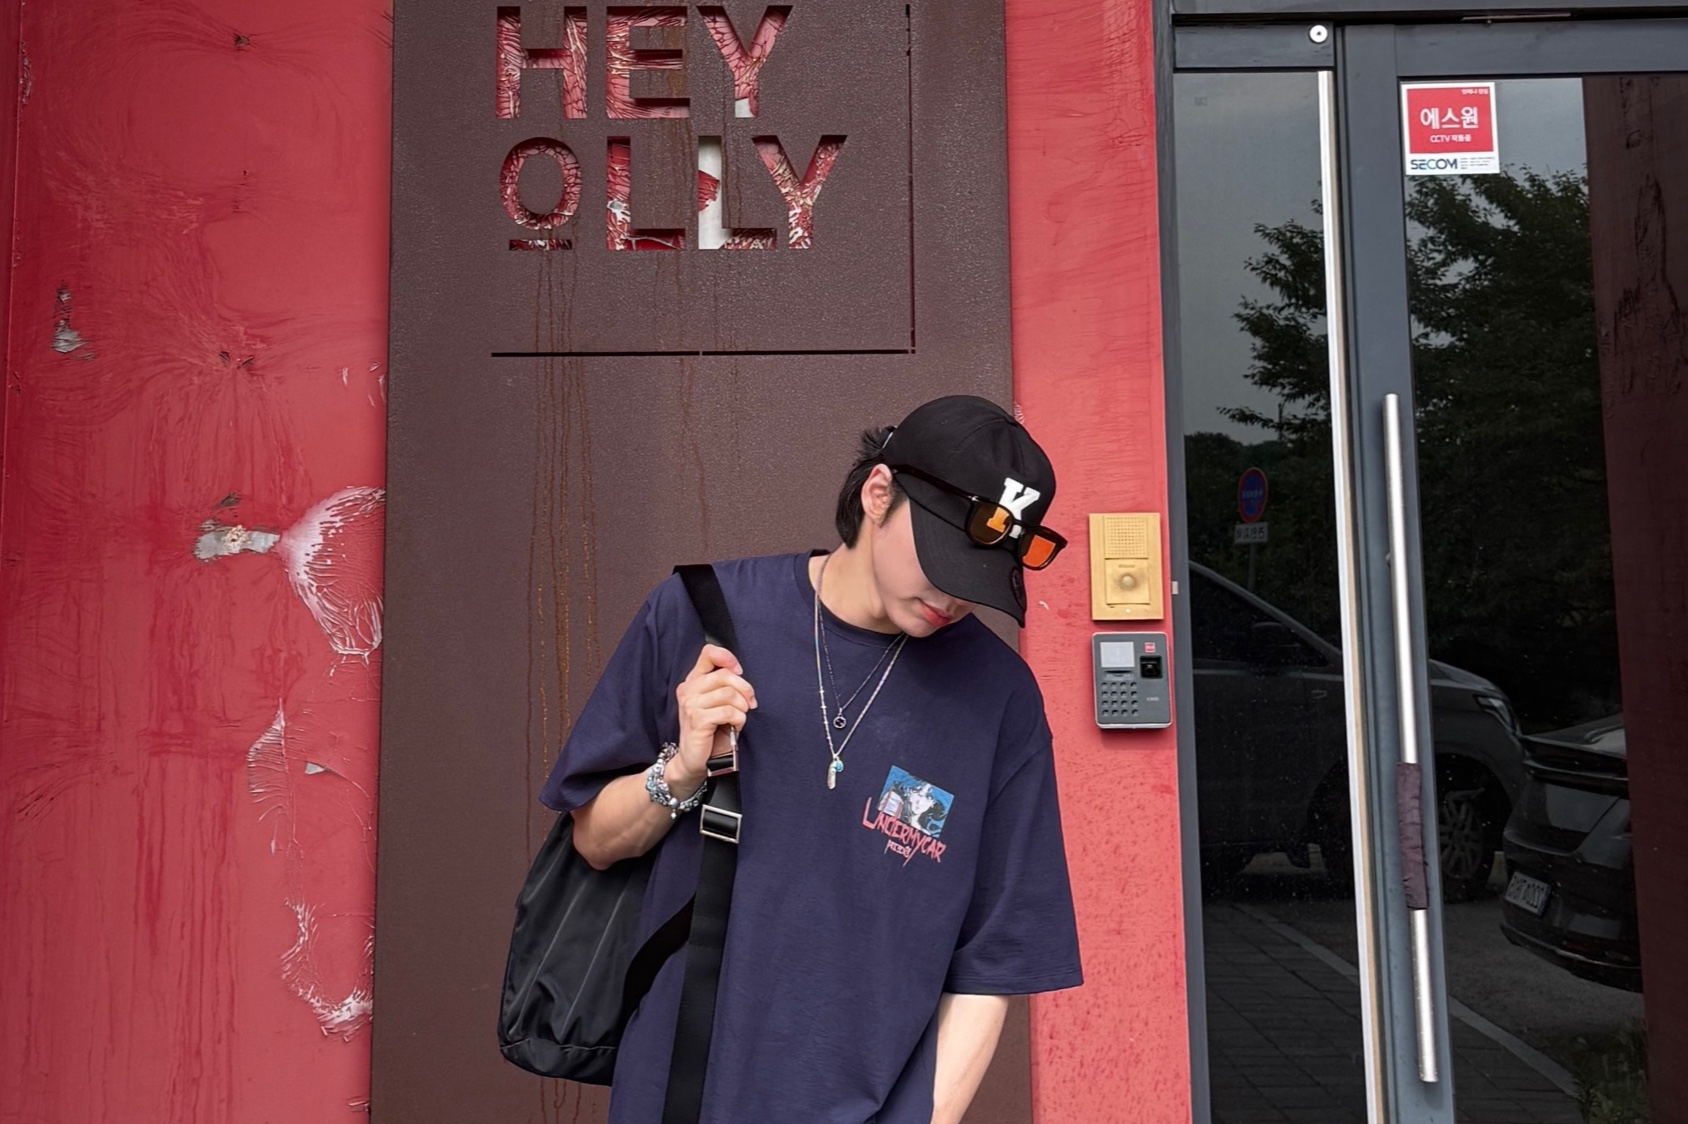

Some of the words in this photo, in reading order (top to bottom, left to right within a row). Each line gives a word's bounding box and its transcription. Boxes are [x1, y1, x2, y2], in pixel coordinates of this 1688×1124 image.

[495, 5, 794, 119] HEY
[1420, 106, 1479, 130] 에스원
[1430, 134, 1450, 143] CCTV
[1410, 158, 1458, 170] SECOM
[499, 135, 848, 251] OLLY
